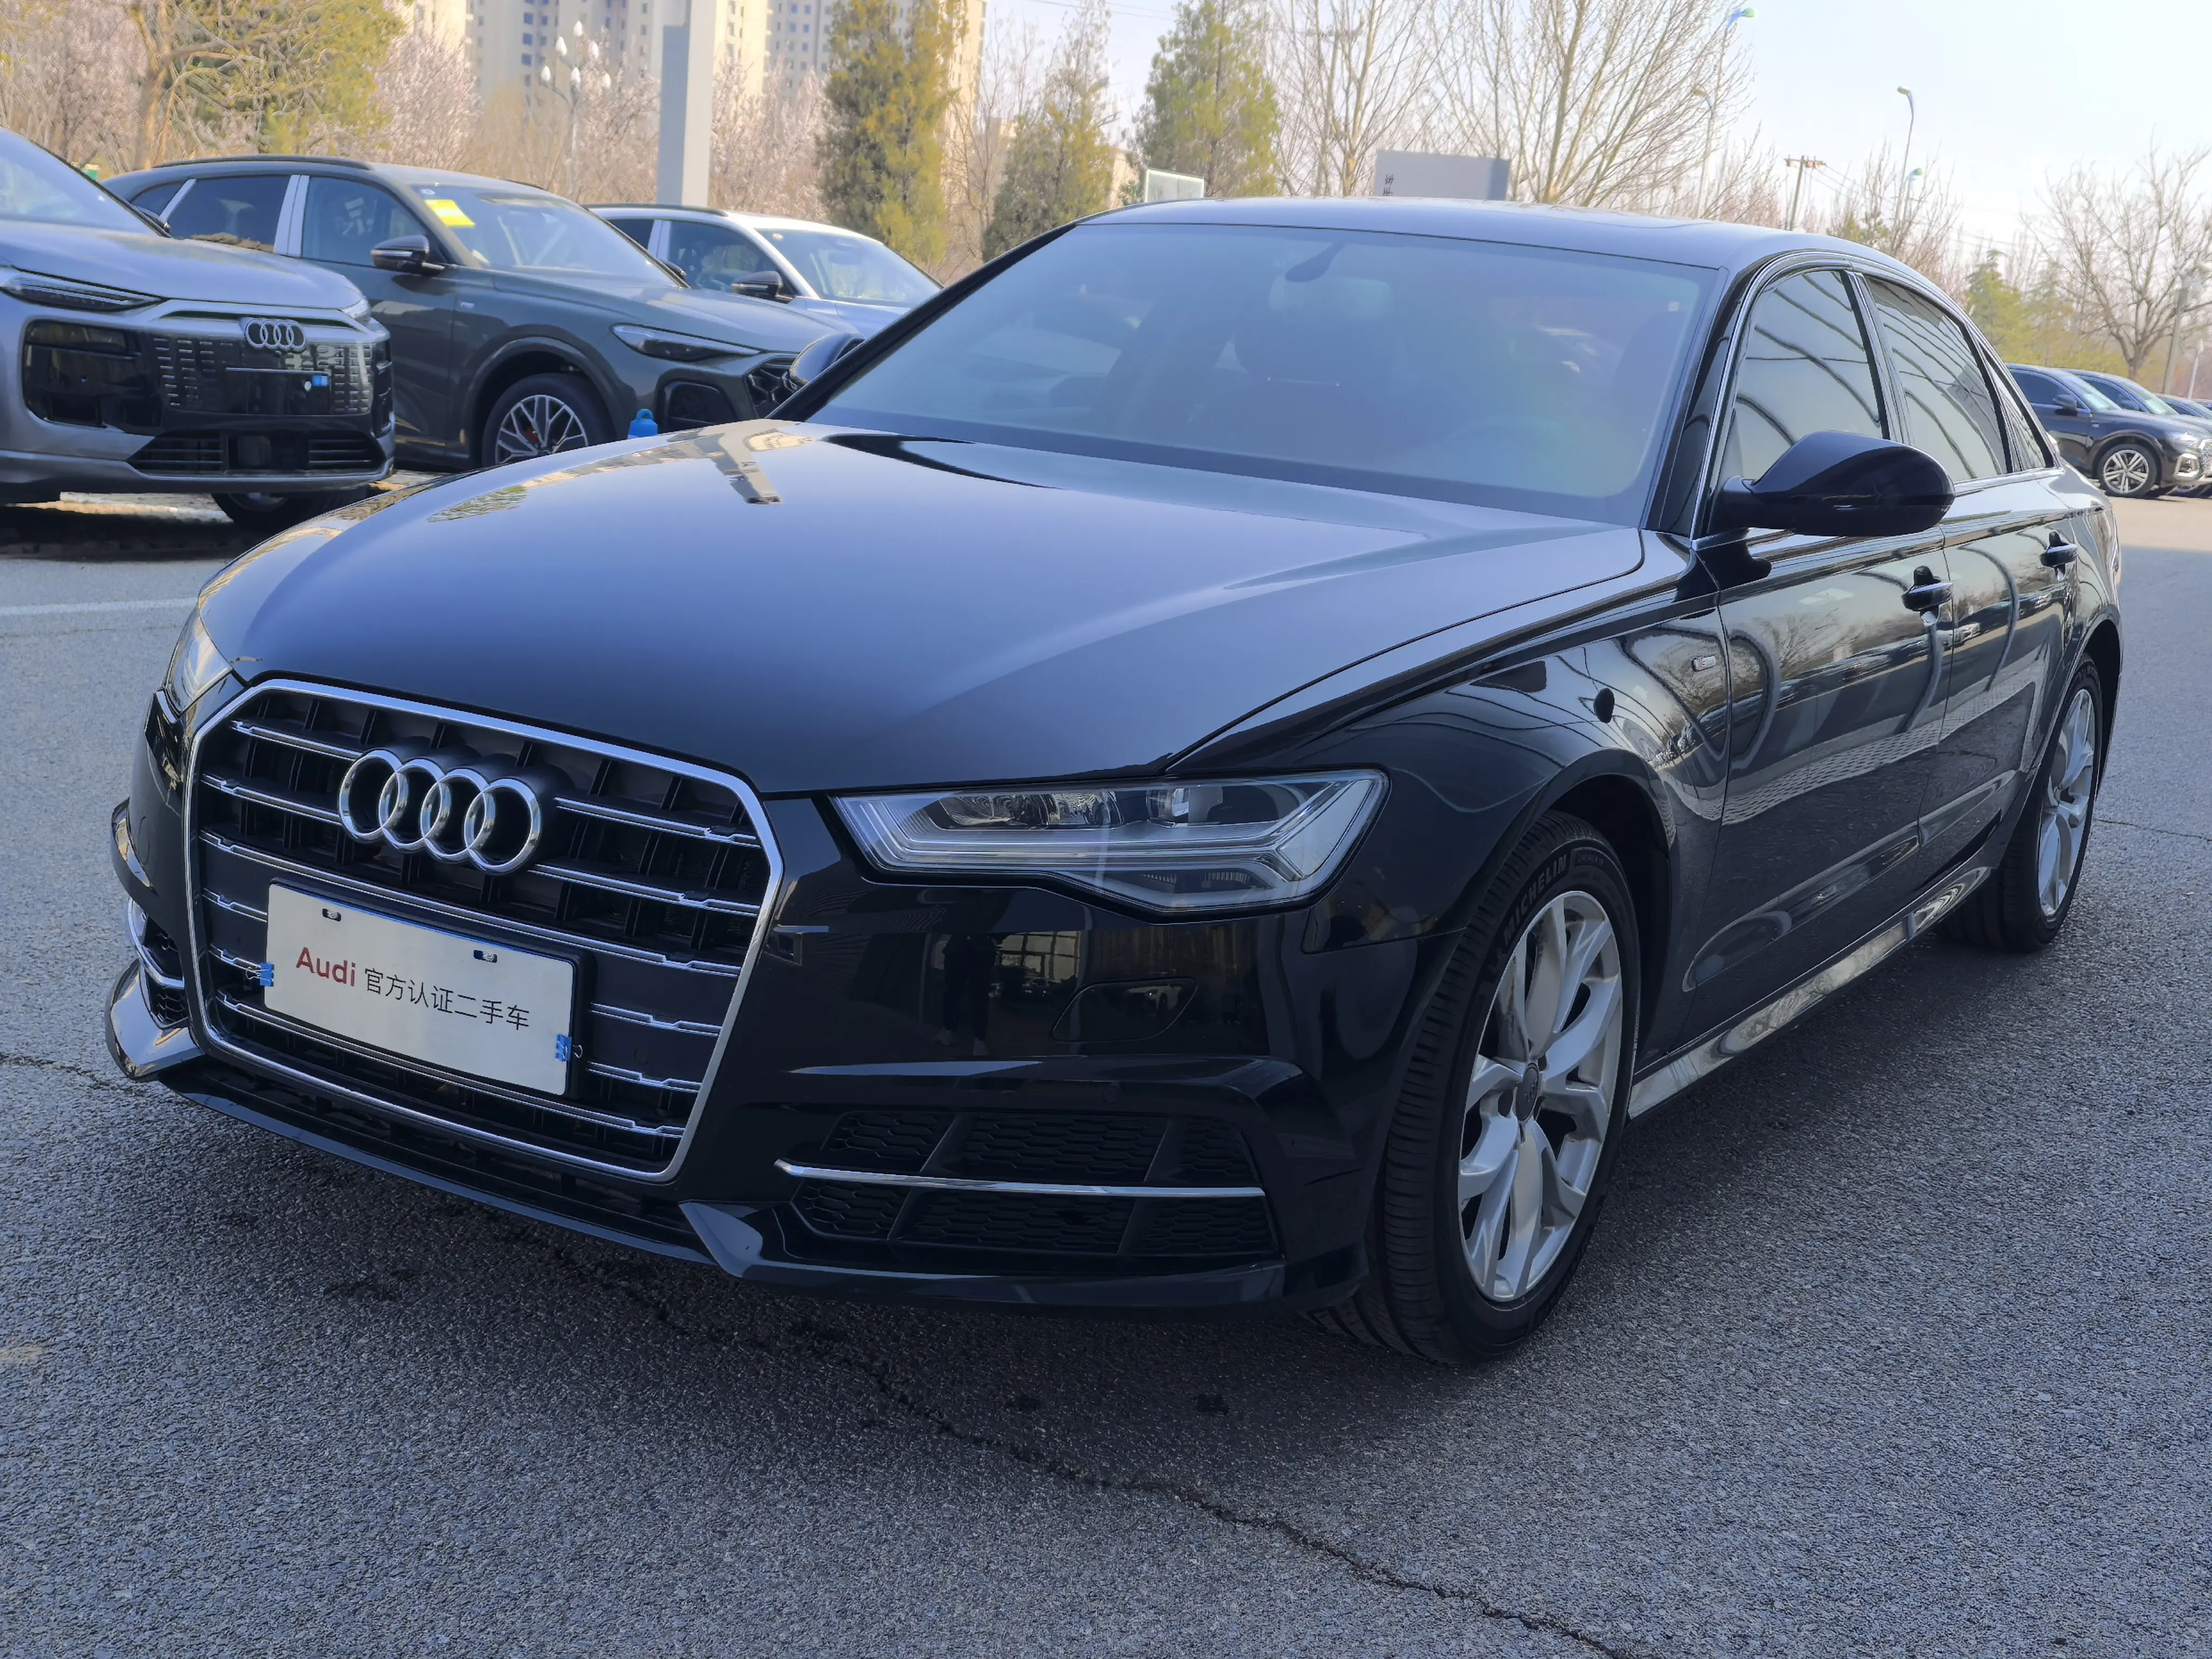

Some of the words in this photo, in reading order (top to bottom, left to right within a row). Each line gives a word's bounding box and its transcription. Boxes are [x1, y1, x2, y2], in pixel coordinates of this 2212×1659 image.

[1503, 854, 1567, 946] MICHELIN
[295, 947, 356, 987] Audi
[365, 968, 530, 1030] 官方认证二手车
